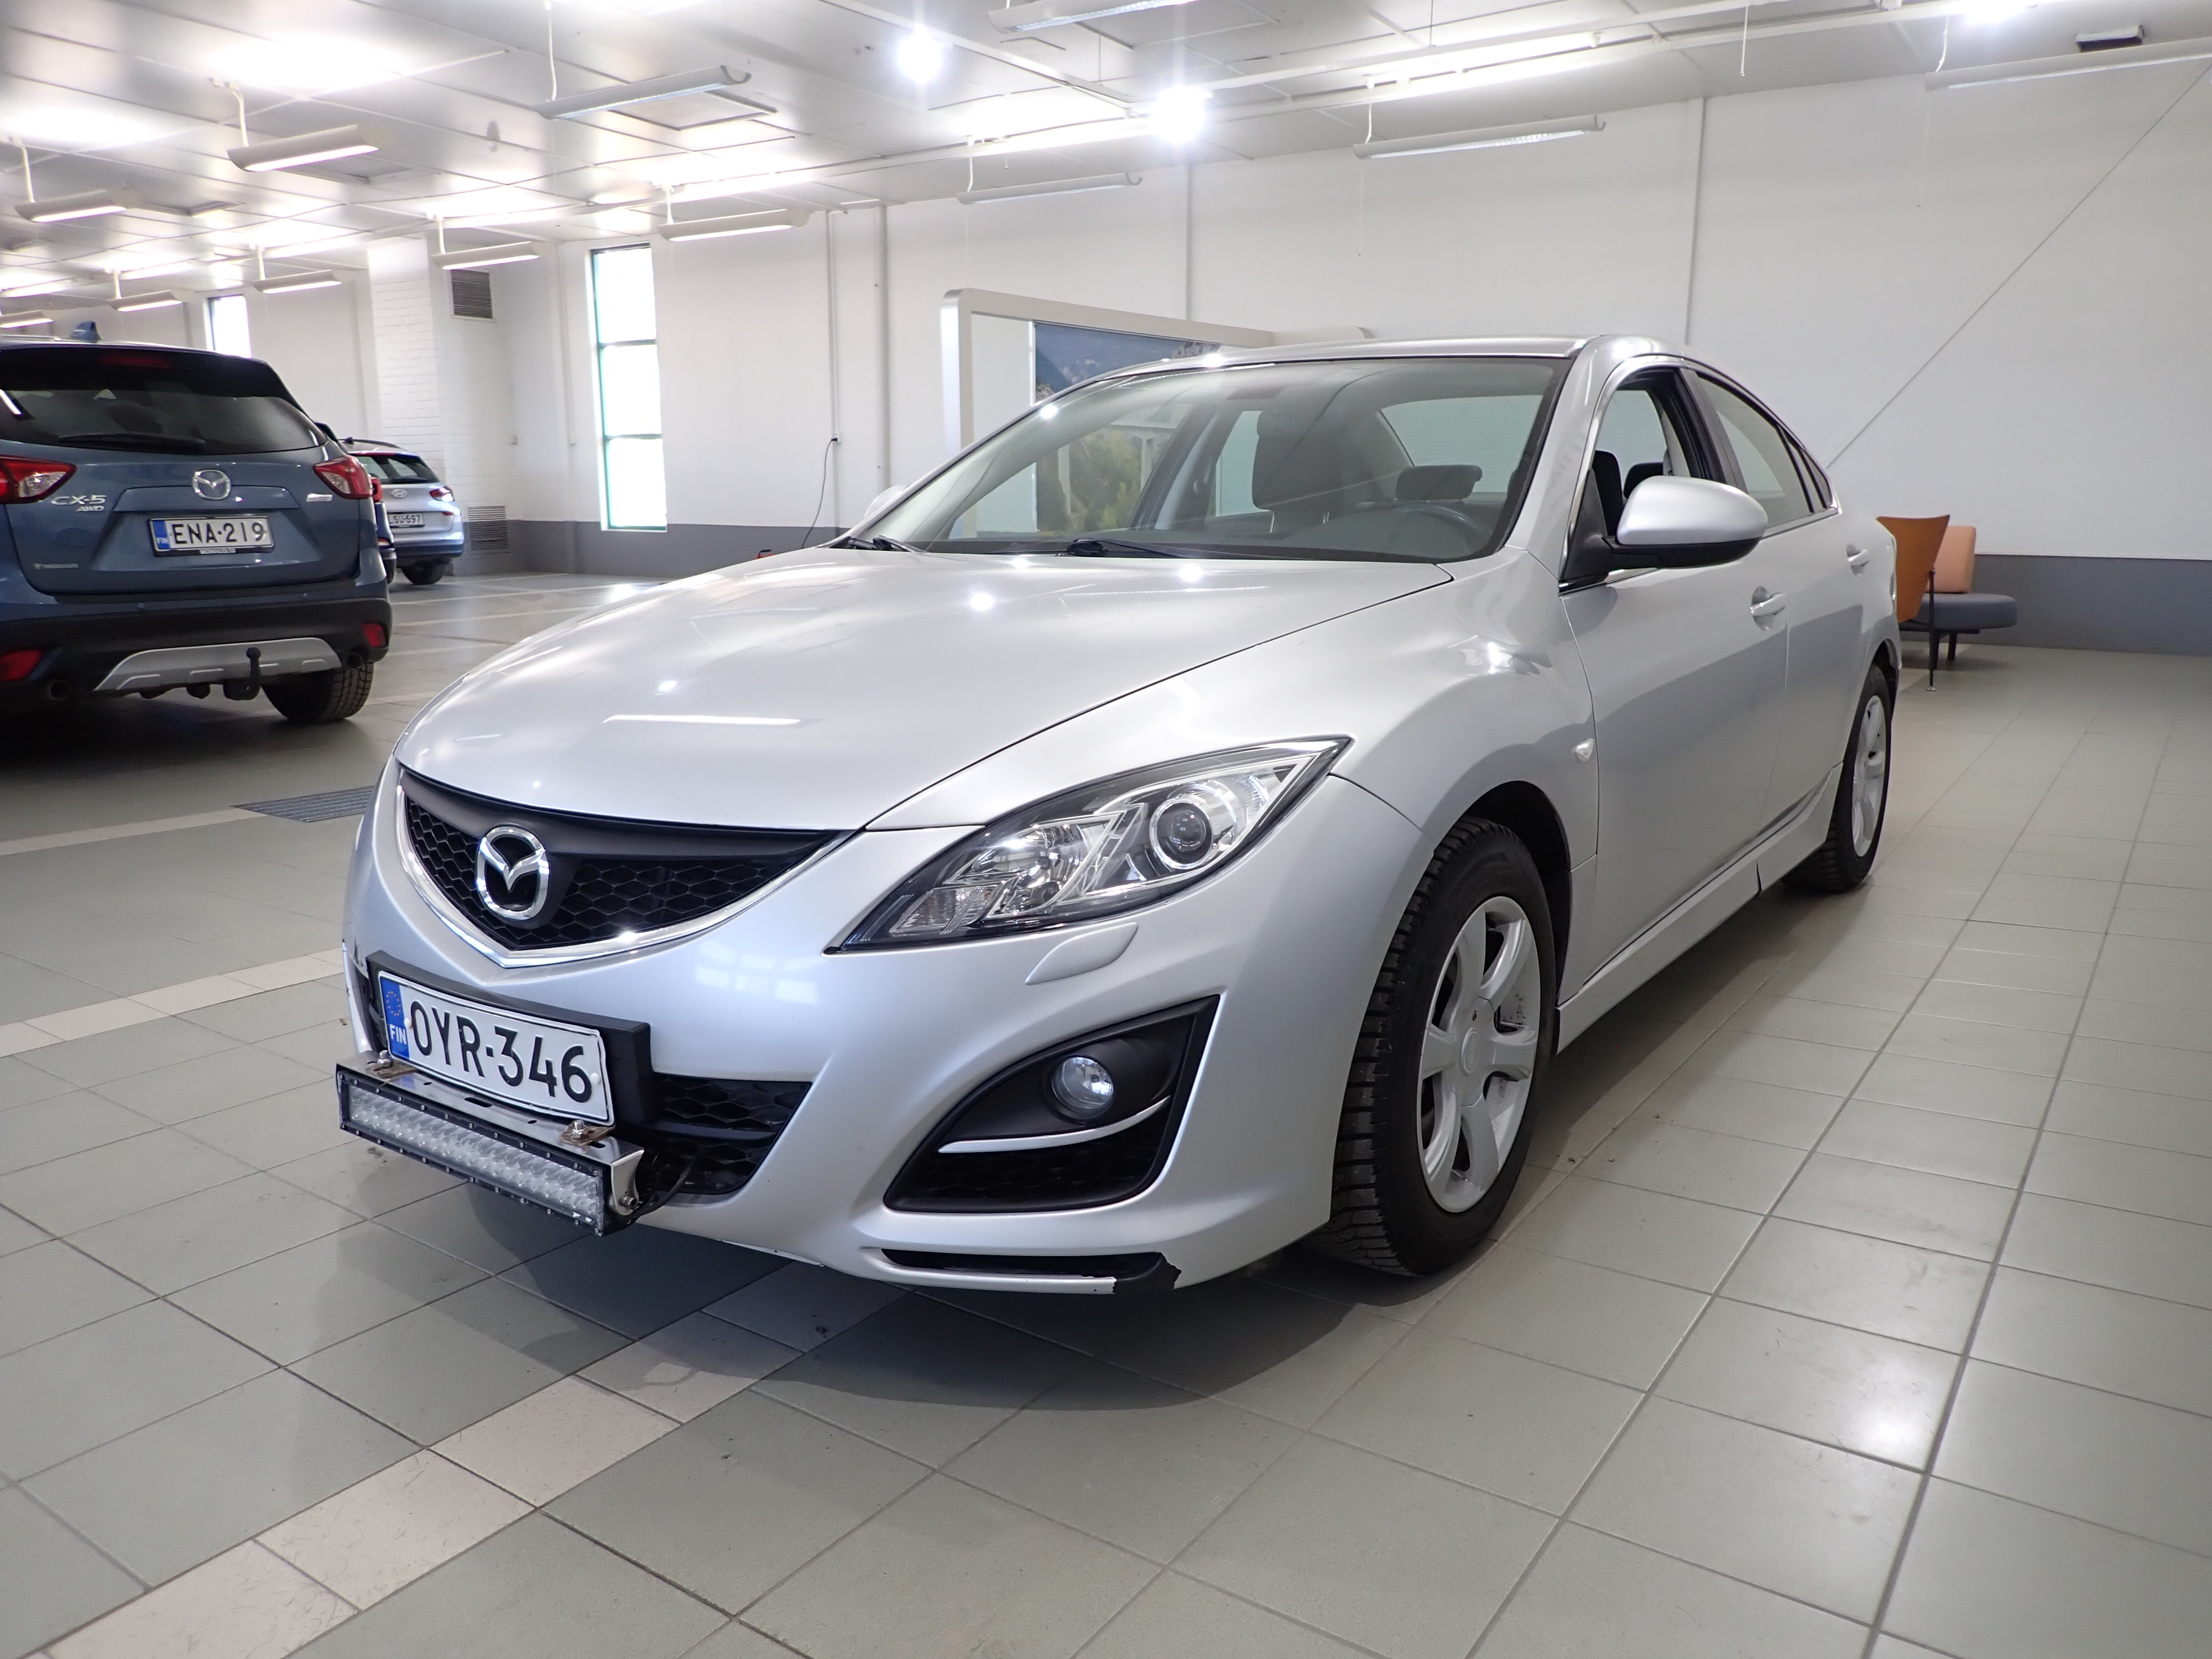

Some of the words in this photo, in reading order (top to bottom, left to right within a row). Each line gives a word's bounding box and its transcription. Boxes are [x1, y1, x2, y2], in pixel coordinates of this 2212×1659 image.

[51, 495, 106, 505] CX-5
[171, 521, 264, 545] ENA-219
[389, 1024, 407, 1046] FIN
[410, 1000, 593, 1103] OYR-346
